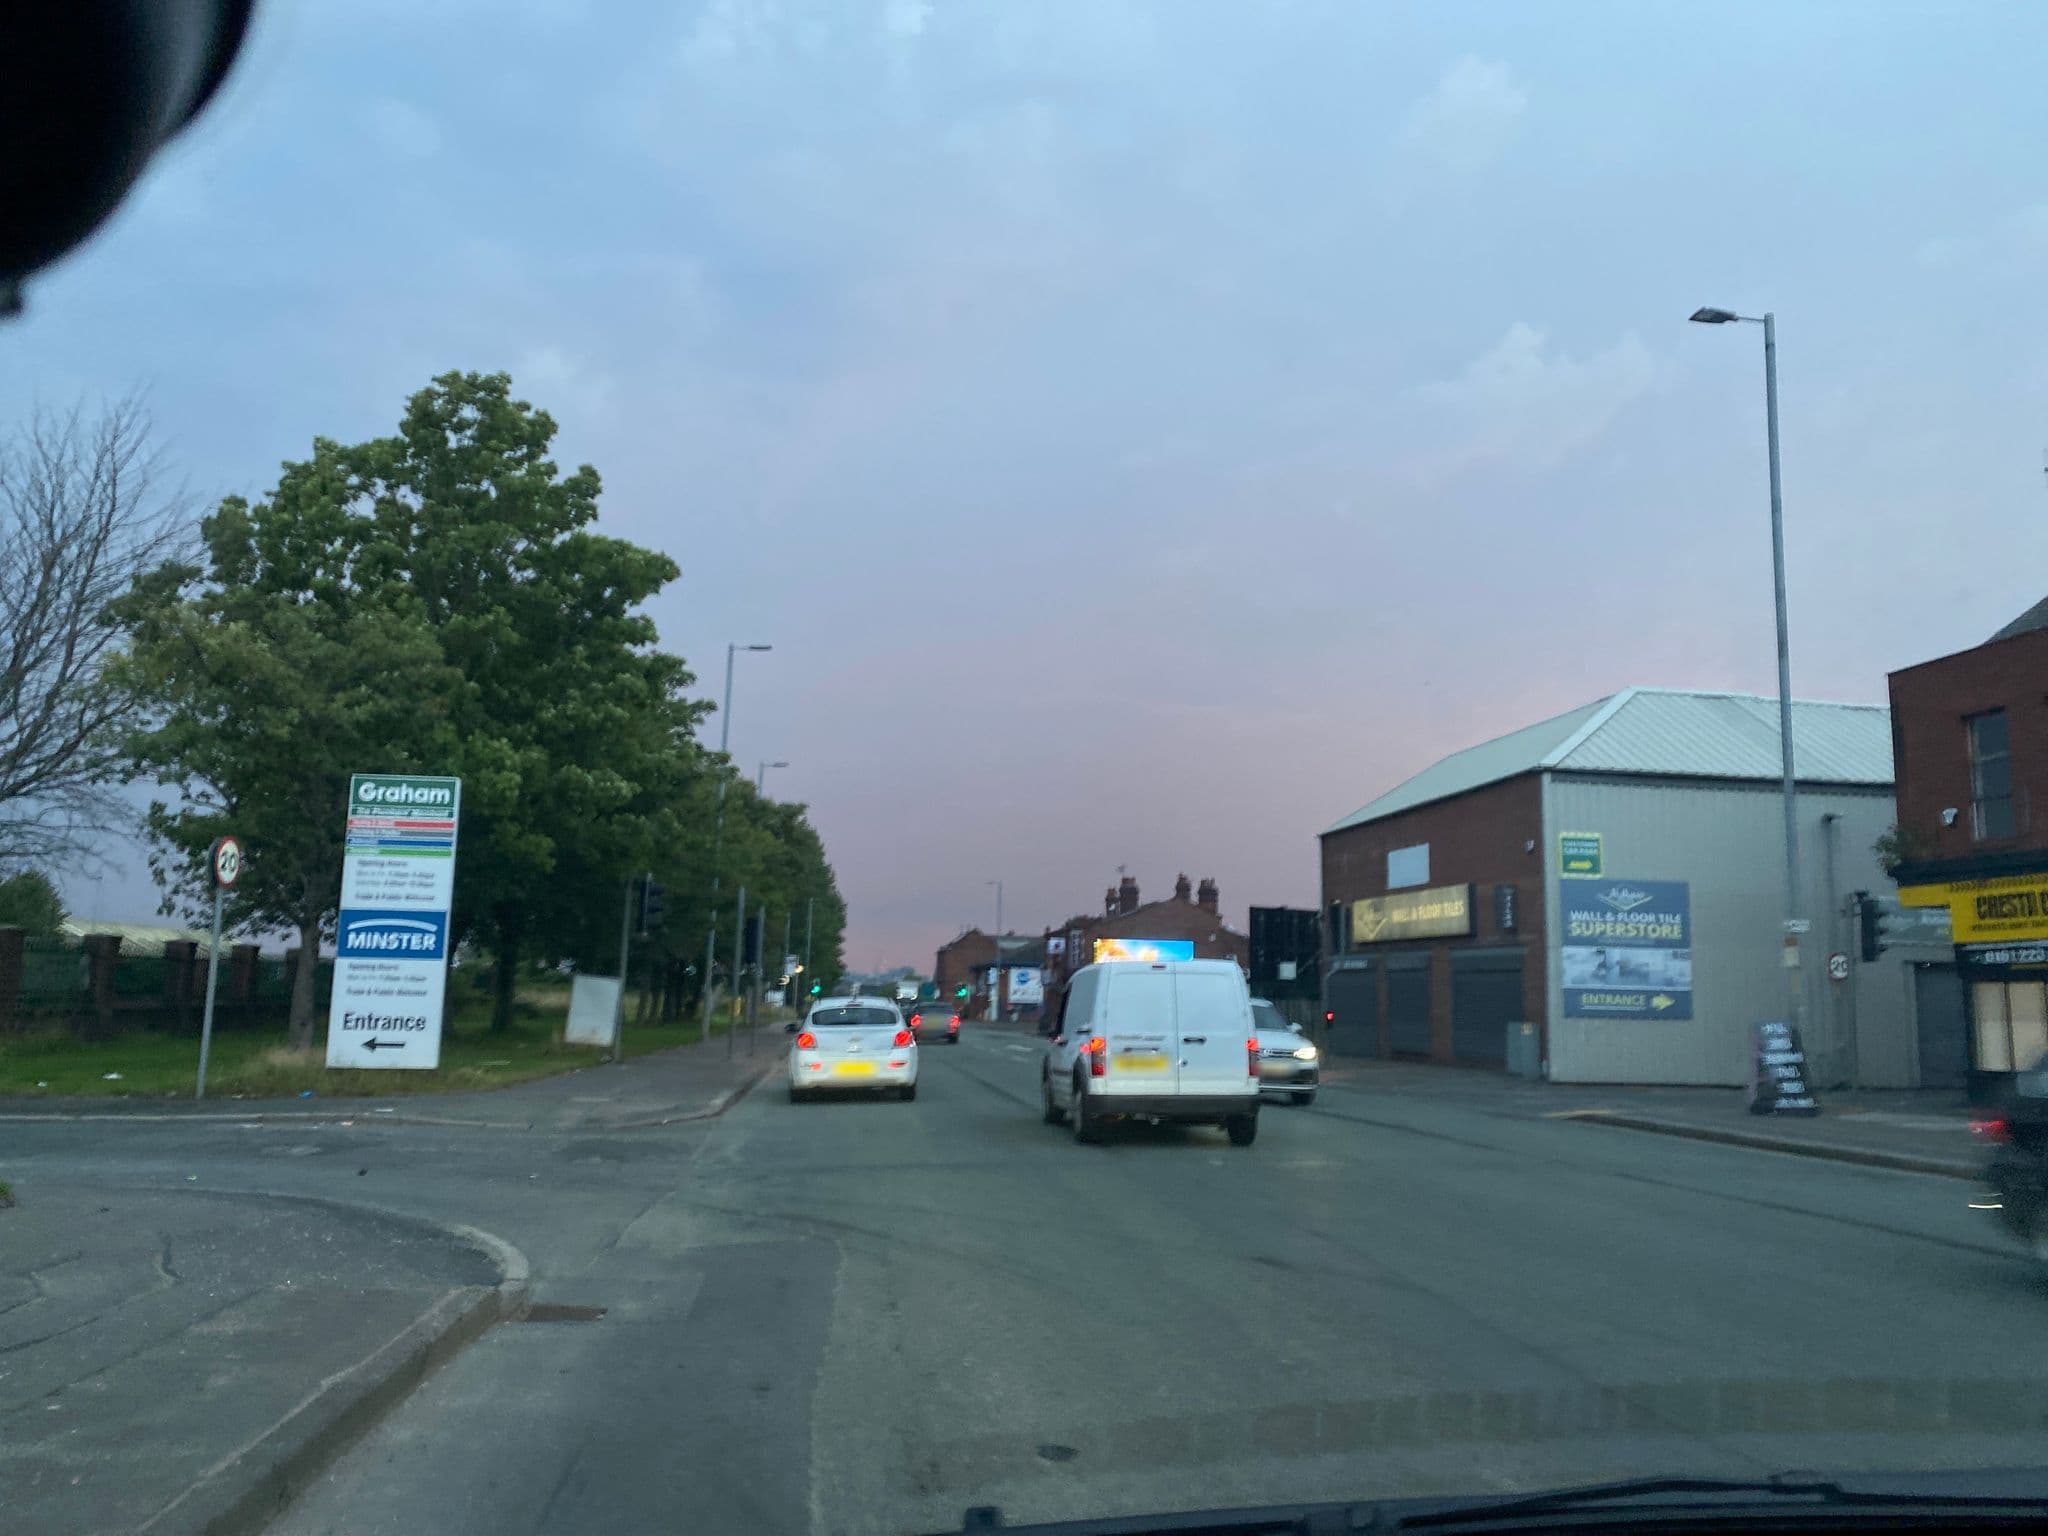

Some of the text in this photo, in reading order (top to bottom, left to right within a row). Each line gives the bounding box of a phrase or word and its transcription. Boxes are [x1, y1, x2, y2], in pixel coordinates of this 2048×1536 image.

[359, 782, 449, 803] Graham
[221, 851, 239, 871] 20
[1570, 910, 1682, 923] WALL & FLOOR TILE
[1568, 921, 1682, 938] SUPERSTORE
[346, 932, 437, 950] MINSTER
[1832, 959, 1848, 973] 20
[1582, 993, 1646, 1006] ENTRANCE
[343, 1012, 426, 1031] Entrance
